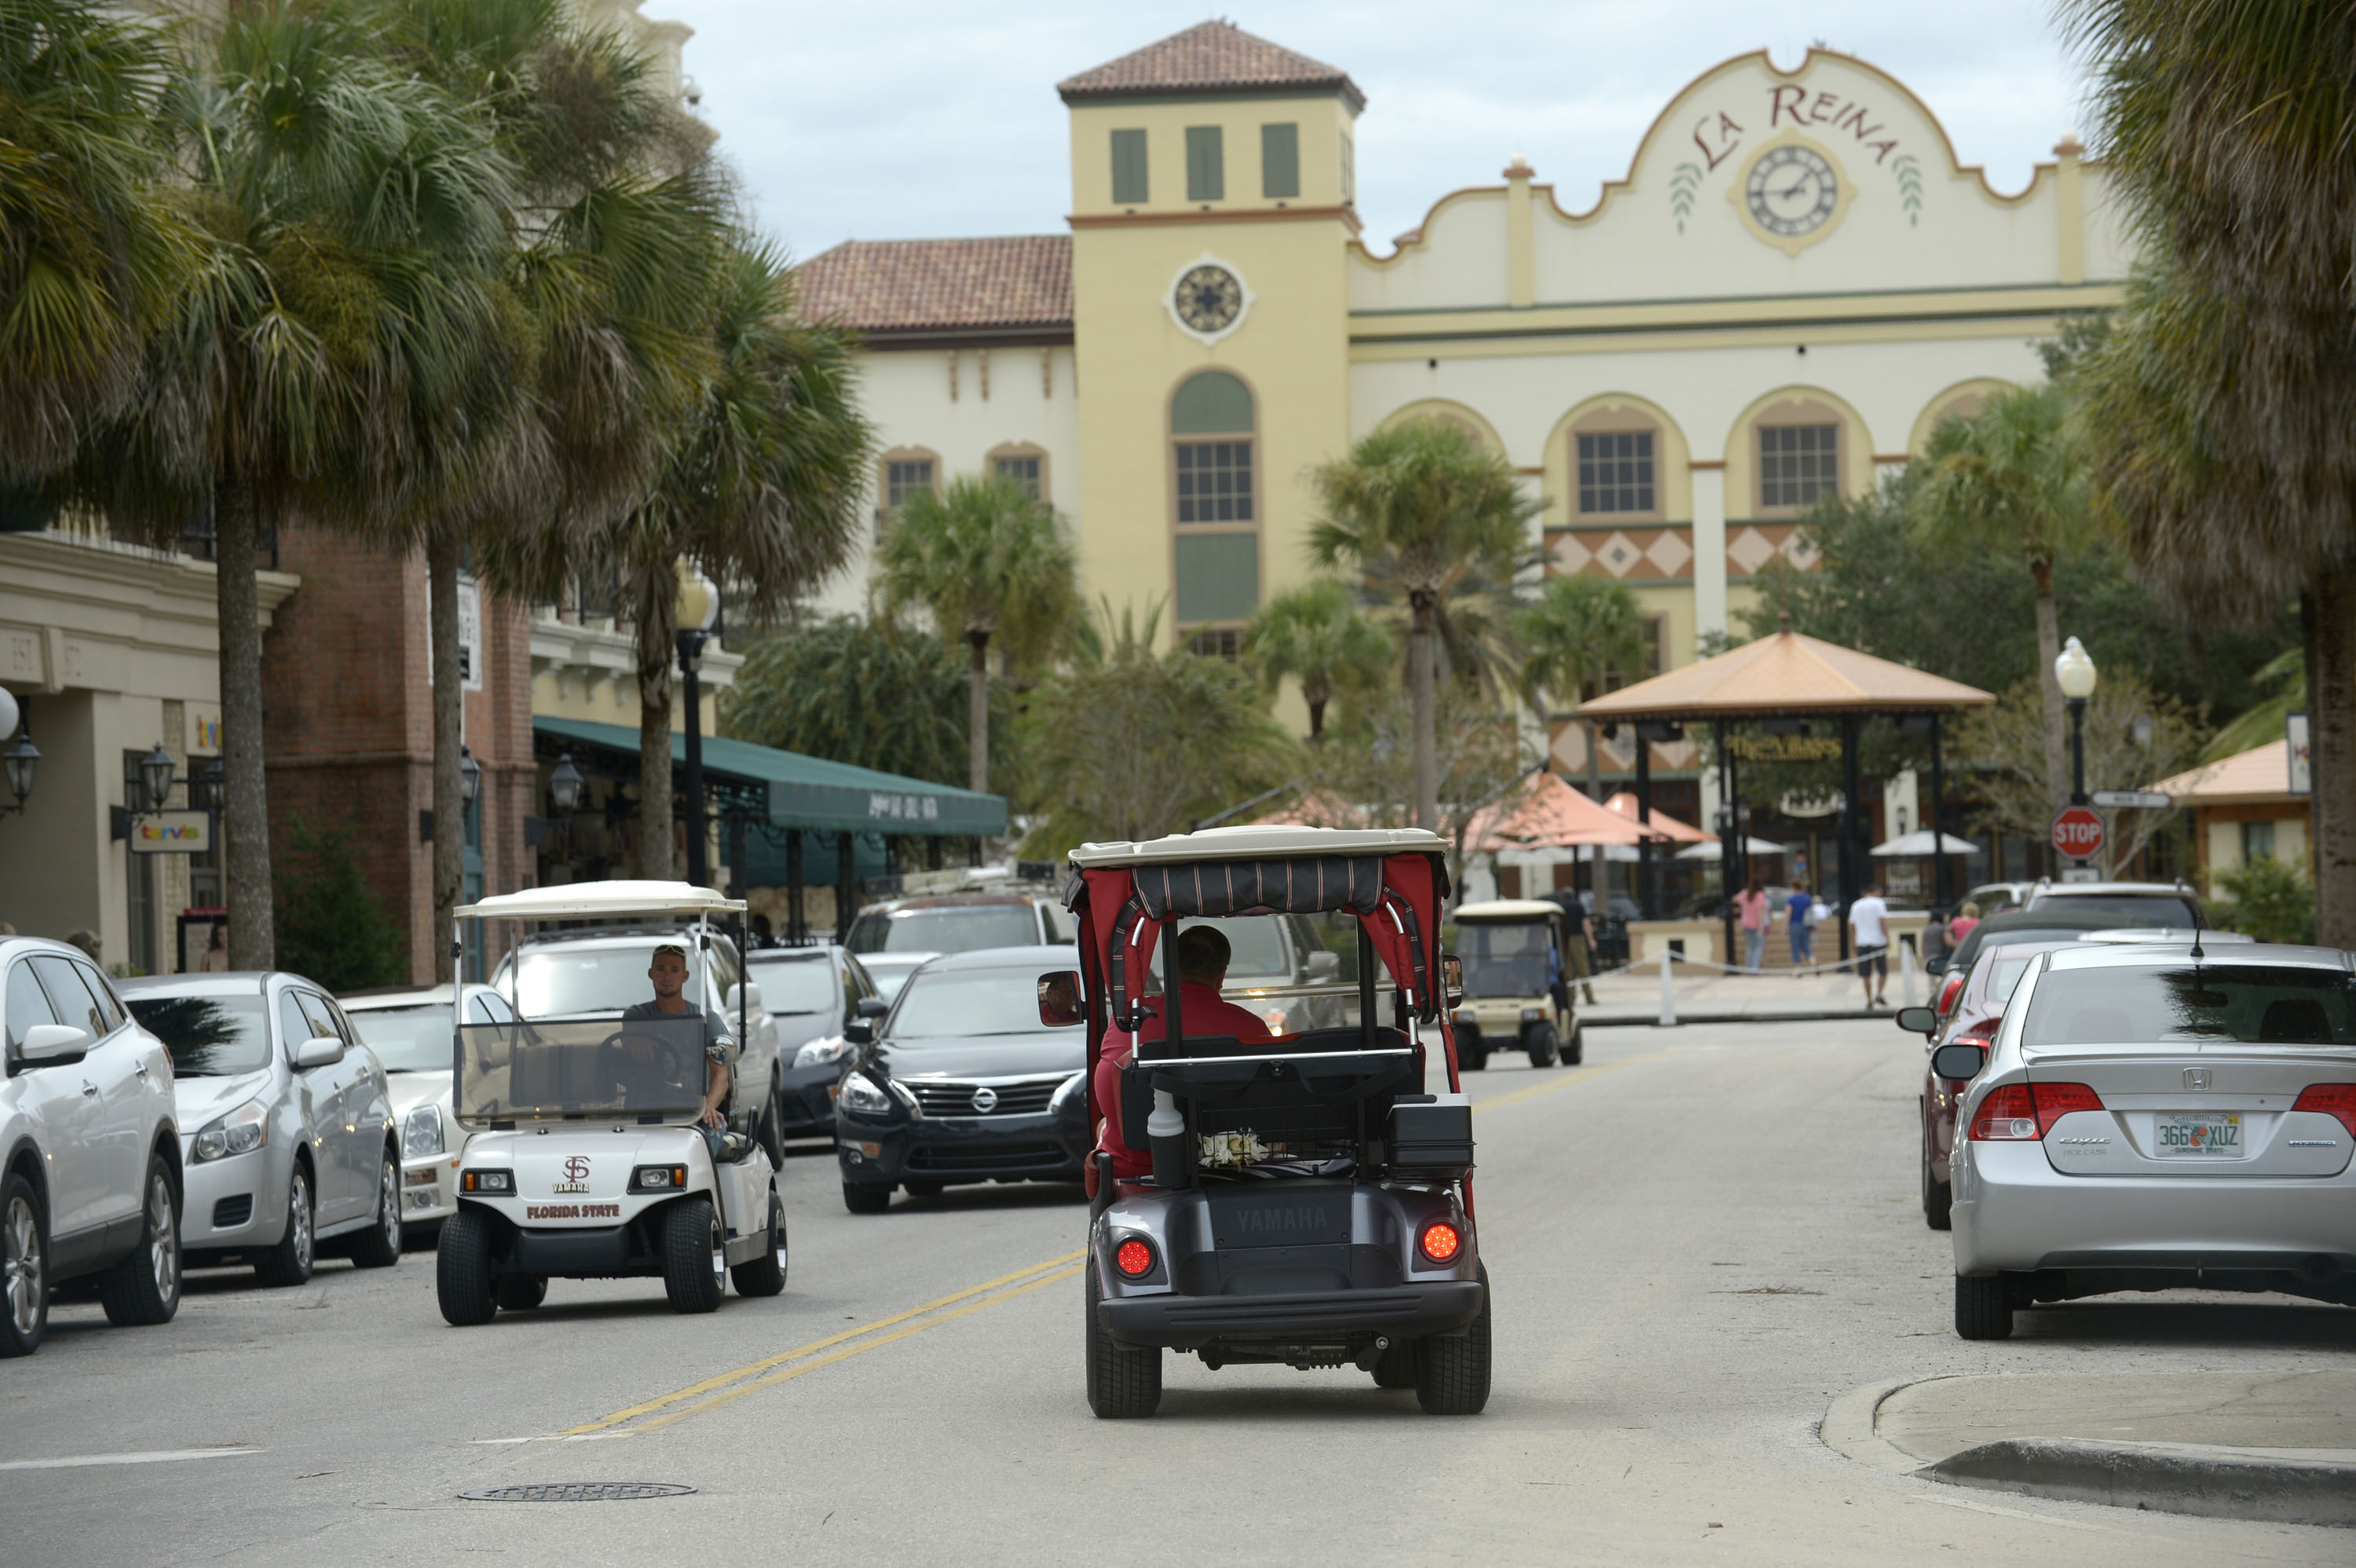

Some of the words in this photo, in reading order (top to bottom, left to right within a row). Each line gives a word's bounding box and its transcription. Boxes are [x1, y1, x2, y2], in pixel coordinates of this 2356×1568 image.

[1694, 111, 1744, 172] LA
[1768, 83, 1898, 165] REINA
[2055, 822, 2101, 844] STOP
[2160, 1125, 2189, 1146] 366
[2208, 1125, 2238, 1146] XUZ
[553, 1182, 590, 1193] YAMAHA
[526, 1205, 580, 1219] FLORIDA
[582, 1204, 620, 1218] STATE
[1236, 1206, 1328, 1232] YAMAHA
